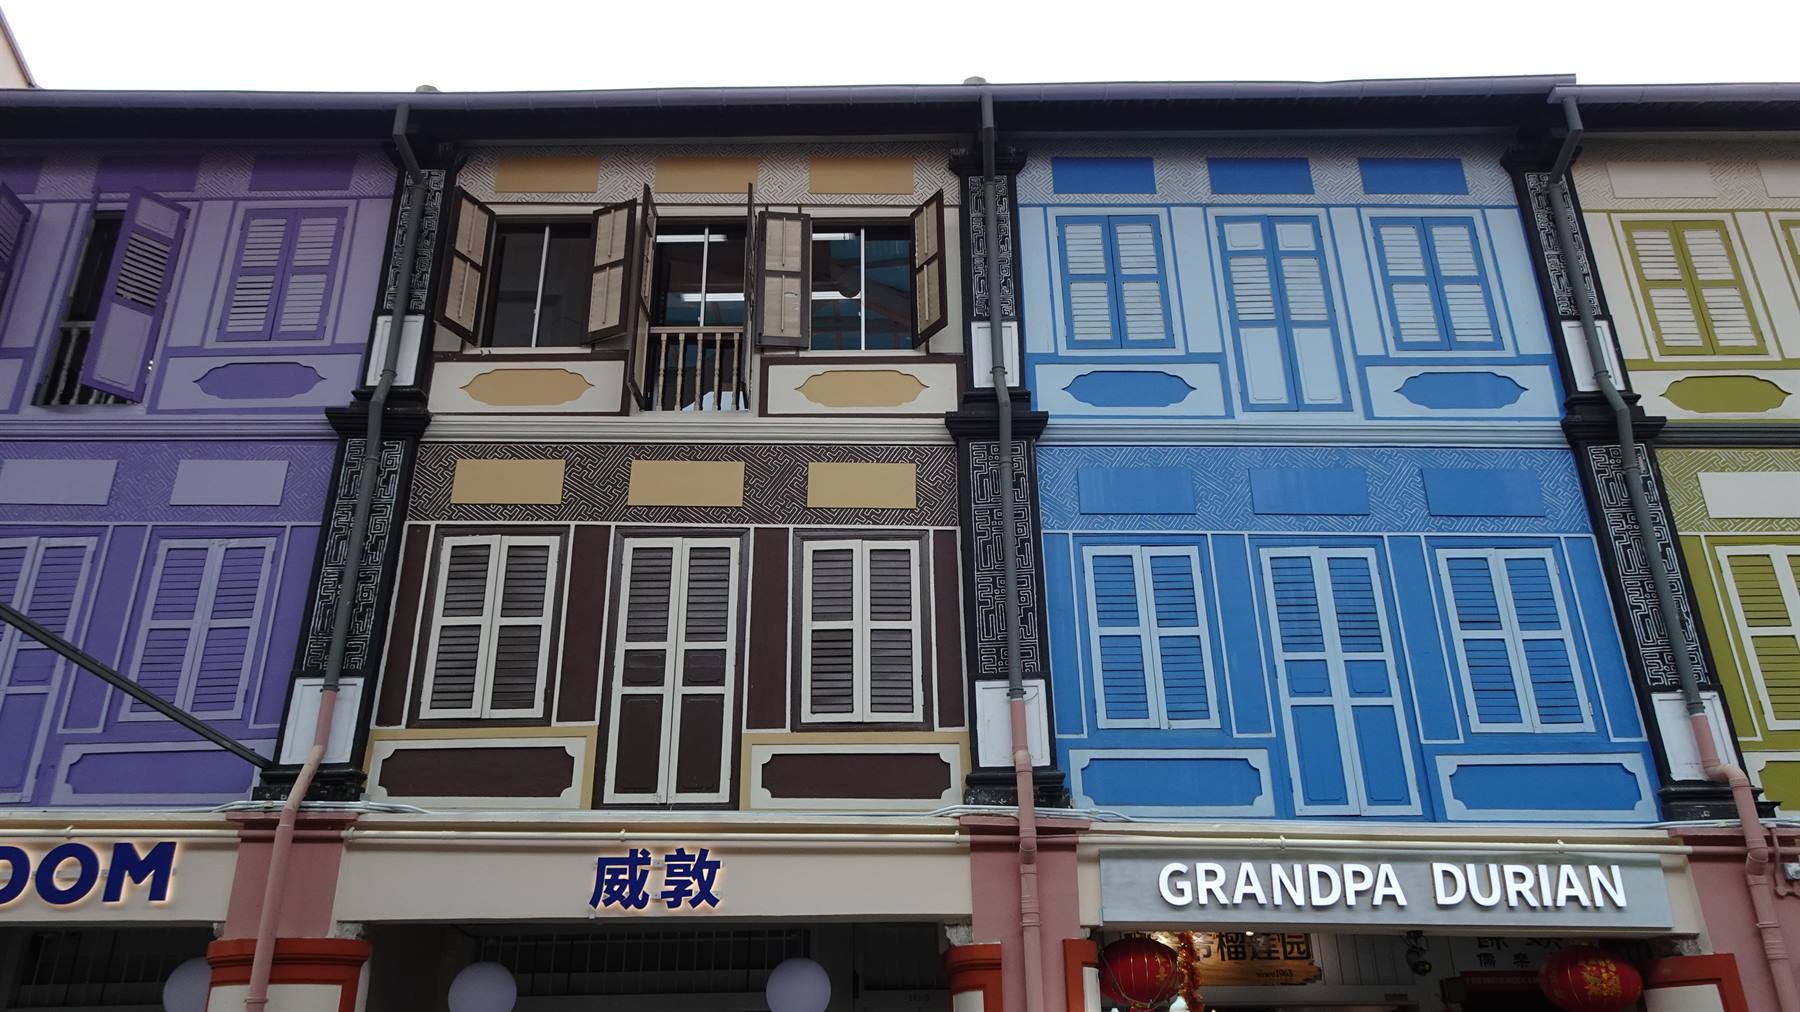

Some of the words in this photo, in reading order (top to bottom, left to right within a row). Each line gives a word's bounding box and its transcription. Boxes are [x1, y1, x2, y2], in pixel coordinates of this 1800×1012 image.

[589, 848, 720, 910] 威敦
[1158, 862, 1408, 906] GRANDPA
[1432, 862, 1628, 908] DURIAN
